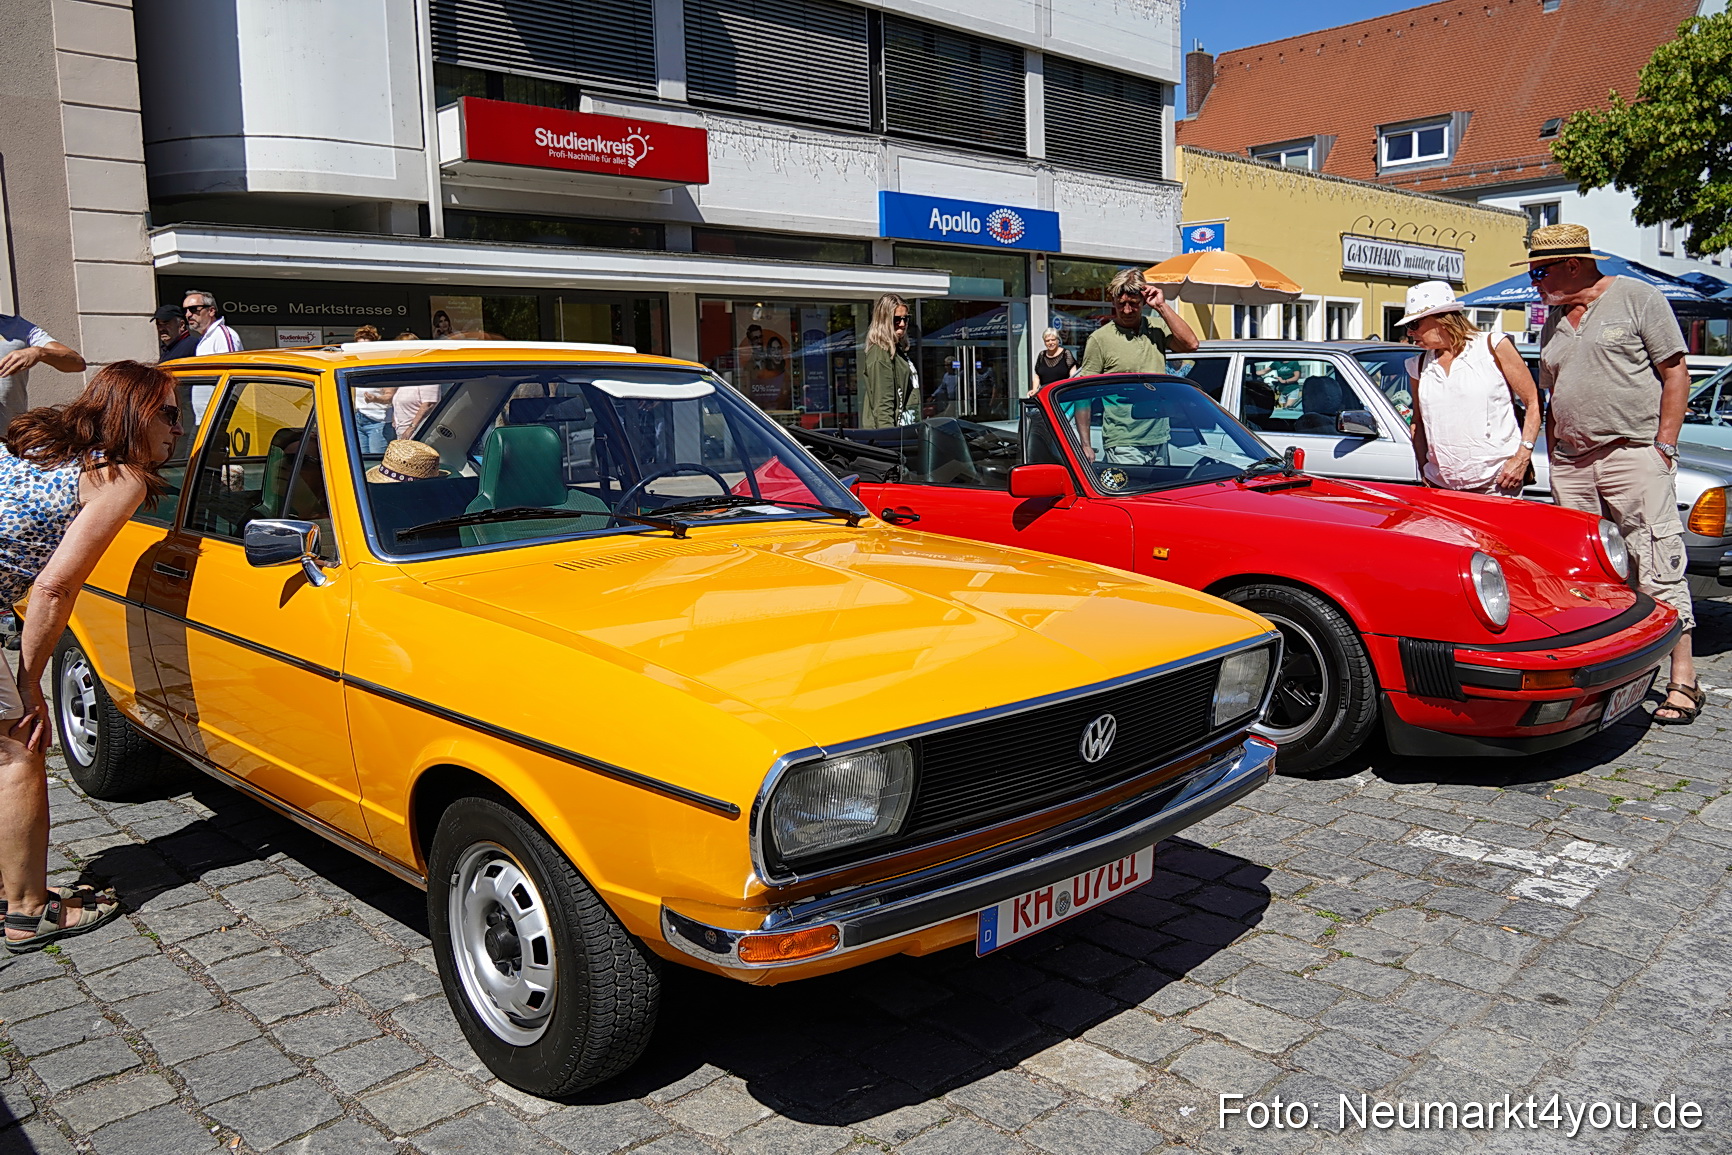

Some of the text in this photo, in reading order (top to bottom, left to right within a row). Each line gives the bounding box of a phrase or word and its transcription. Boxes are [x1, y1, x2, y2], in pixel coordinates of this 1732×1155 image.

[535, 127, 634, 156] Studienkreis
[549, 149, 627, 165] Profi-Nachhilfe für alle!
[929, 207, 981, 236] Apollo
[1347, 243, 1402, 268] GASTHAUS
[1437, 255, 1461, 274] GANS
[222, 301, 407, 315] Obere Marktstrasse 9
[984, 929, 992, 943] D
